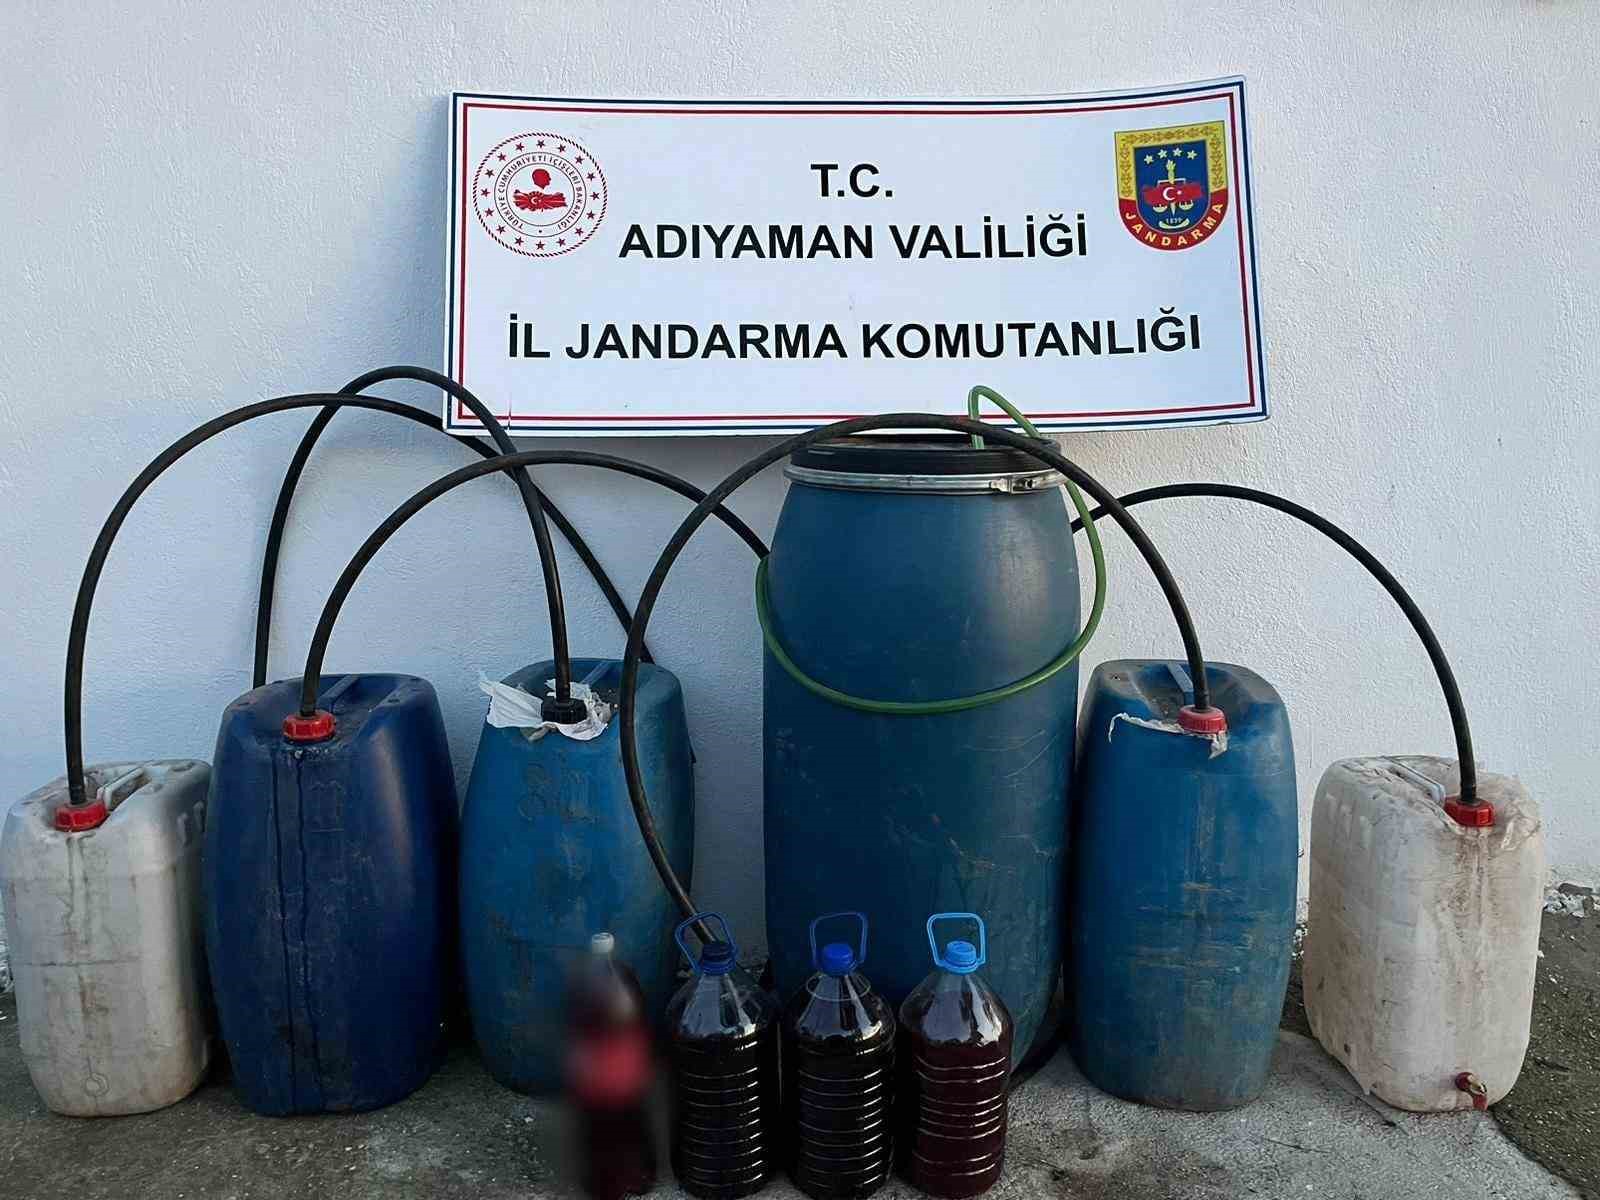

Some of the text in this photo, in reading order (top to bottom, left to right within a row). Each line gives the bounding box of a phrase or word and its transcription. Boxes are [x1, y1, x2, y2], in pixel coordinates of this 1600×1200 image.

[811, 164, 893, 197] T.C.
[620, 214, 1087, 258] ADIYAMAN VALİLİĞİ
[1125, 203, 1224, 246] JANDARMA
[509, 307, 1201, 360] İL JANDARMA KOMUTANLIĞI
